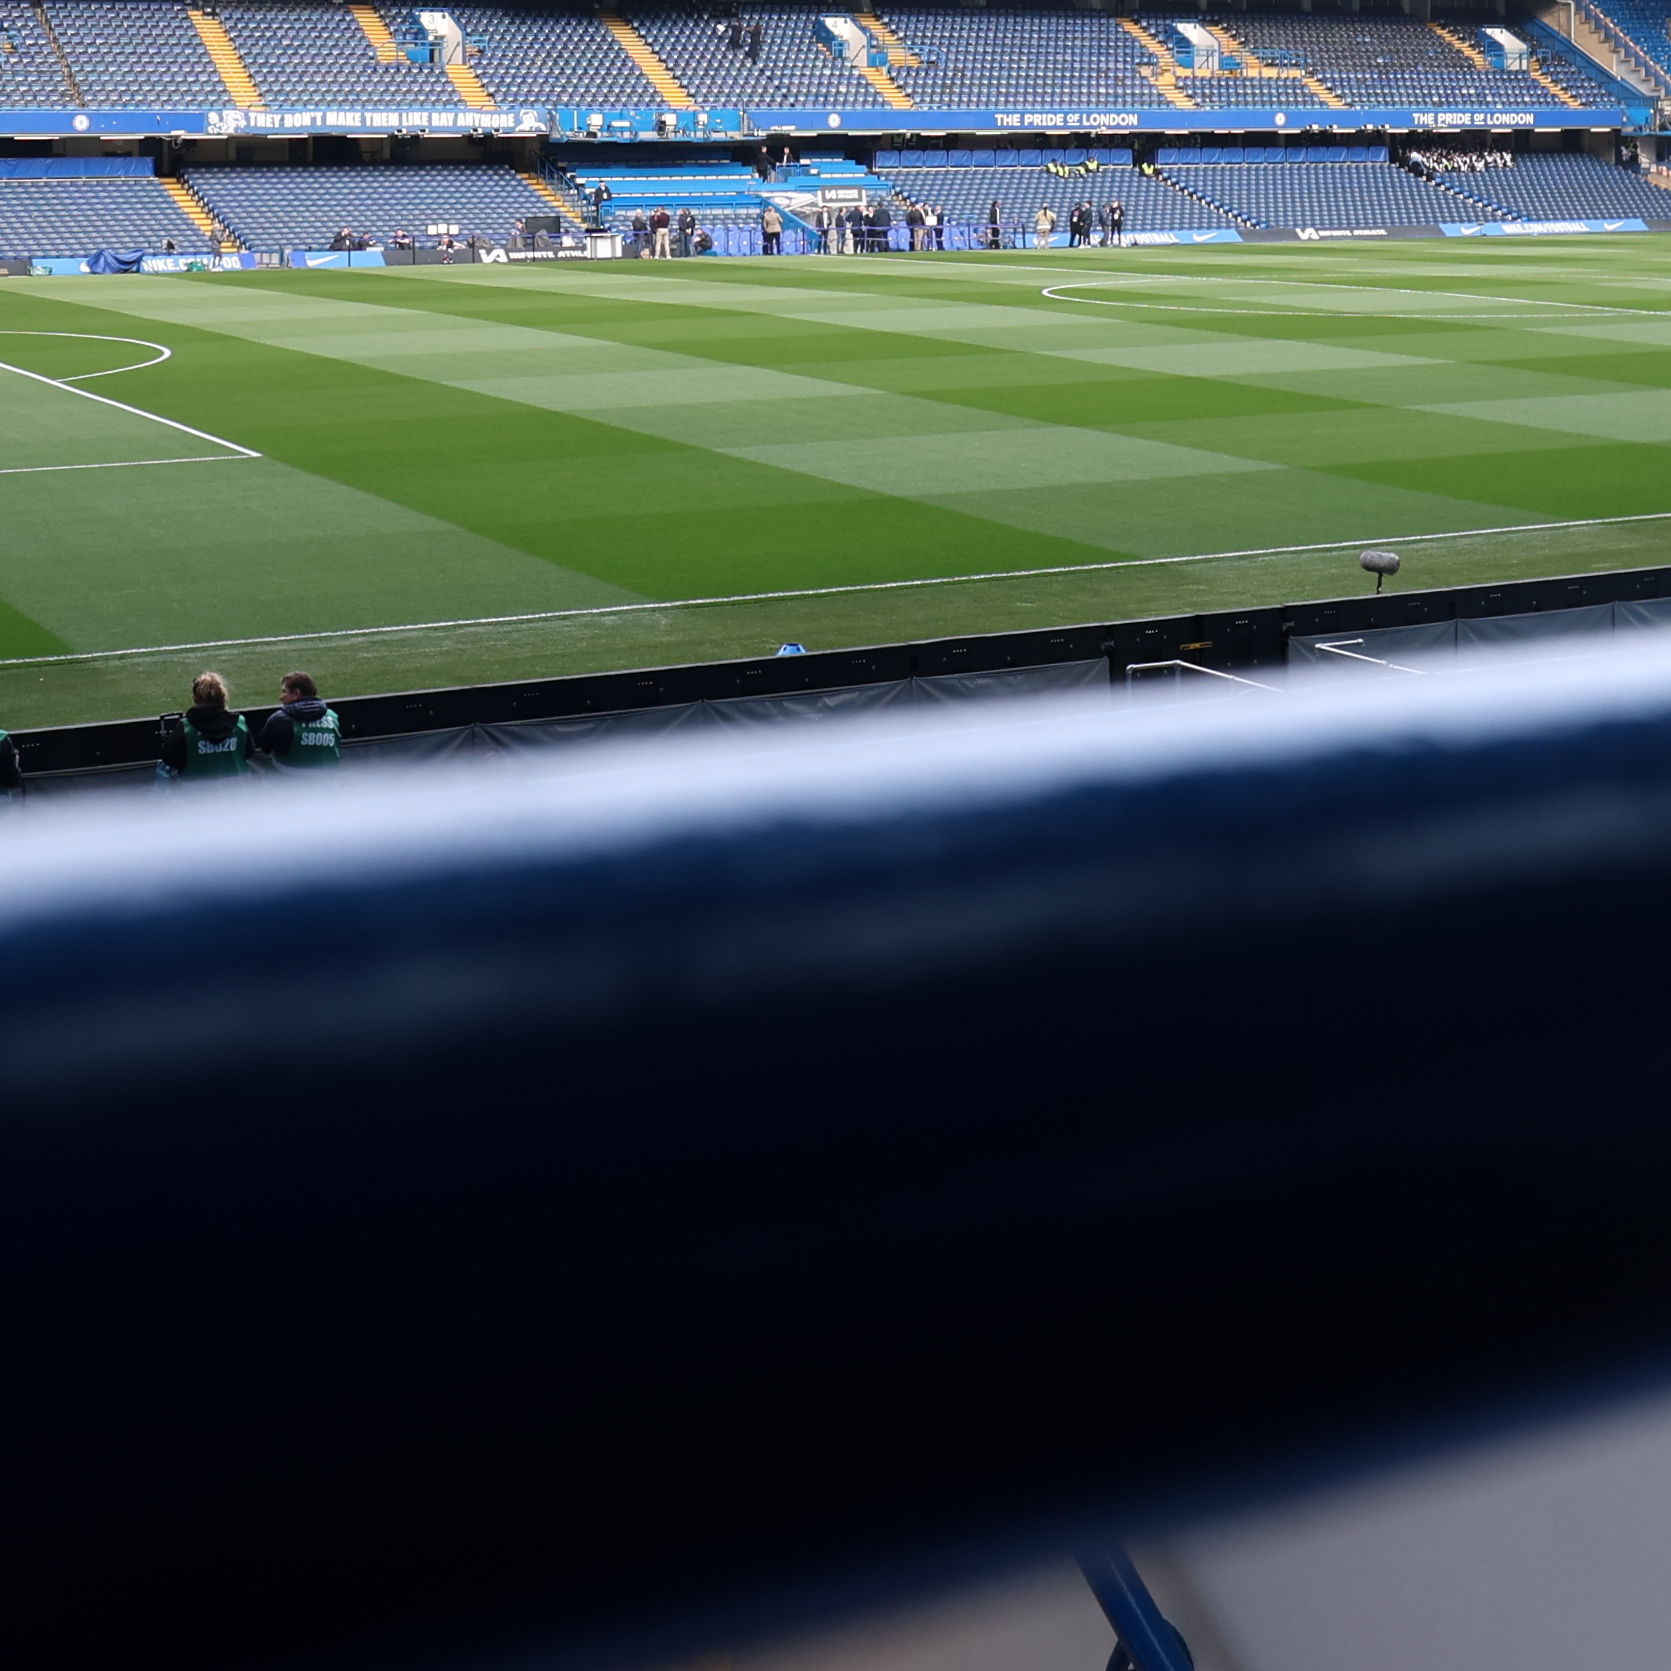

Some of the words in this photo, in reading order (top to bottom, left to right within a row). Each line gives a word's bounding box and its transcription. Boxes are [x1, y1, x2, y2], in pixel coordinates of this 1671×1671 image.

[428, 14, 435, 24] 3
[832, 20, 838, 29] 4
[248, 112, 282, 128] THEY
[283, 112, 324, 128] DON'T
[325, 112, 362, 126] MAKE
[364, 112, 399, 126] THEM
[401, 112, 429, 126] LIKE
[431, 112, 454, 126] RAY
[456, 112, 515, 127] ANYMORE
[994, 114, 1021, 126] THE
[1024, 114, 1064, 126] PRIDE
[1067, 114, 1080, 123] OF
[1083, 114, 1138, 126] LONDON
[1412, 113, 1434, 124] THE
[1438, 113, 1471, 125] PRIDE
[1474, 113, 1485, 122] OF
[1487, 113, 1534, 124] LONDON
[557, 250, 588, 258] ATHL
[302, 715, 335, 729] ESS
[300, 732, 336, 747] SB005
